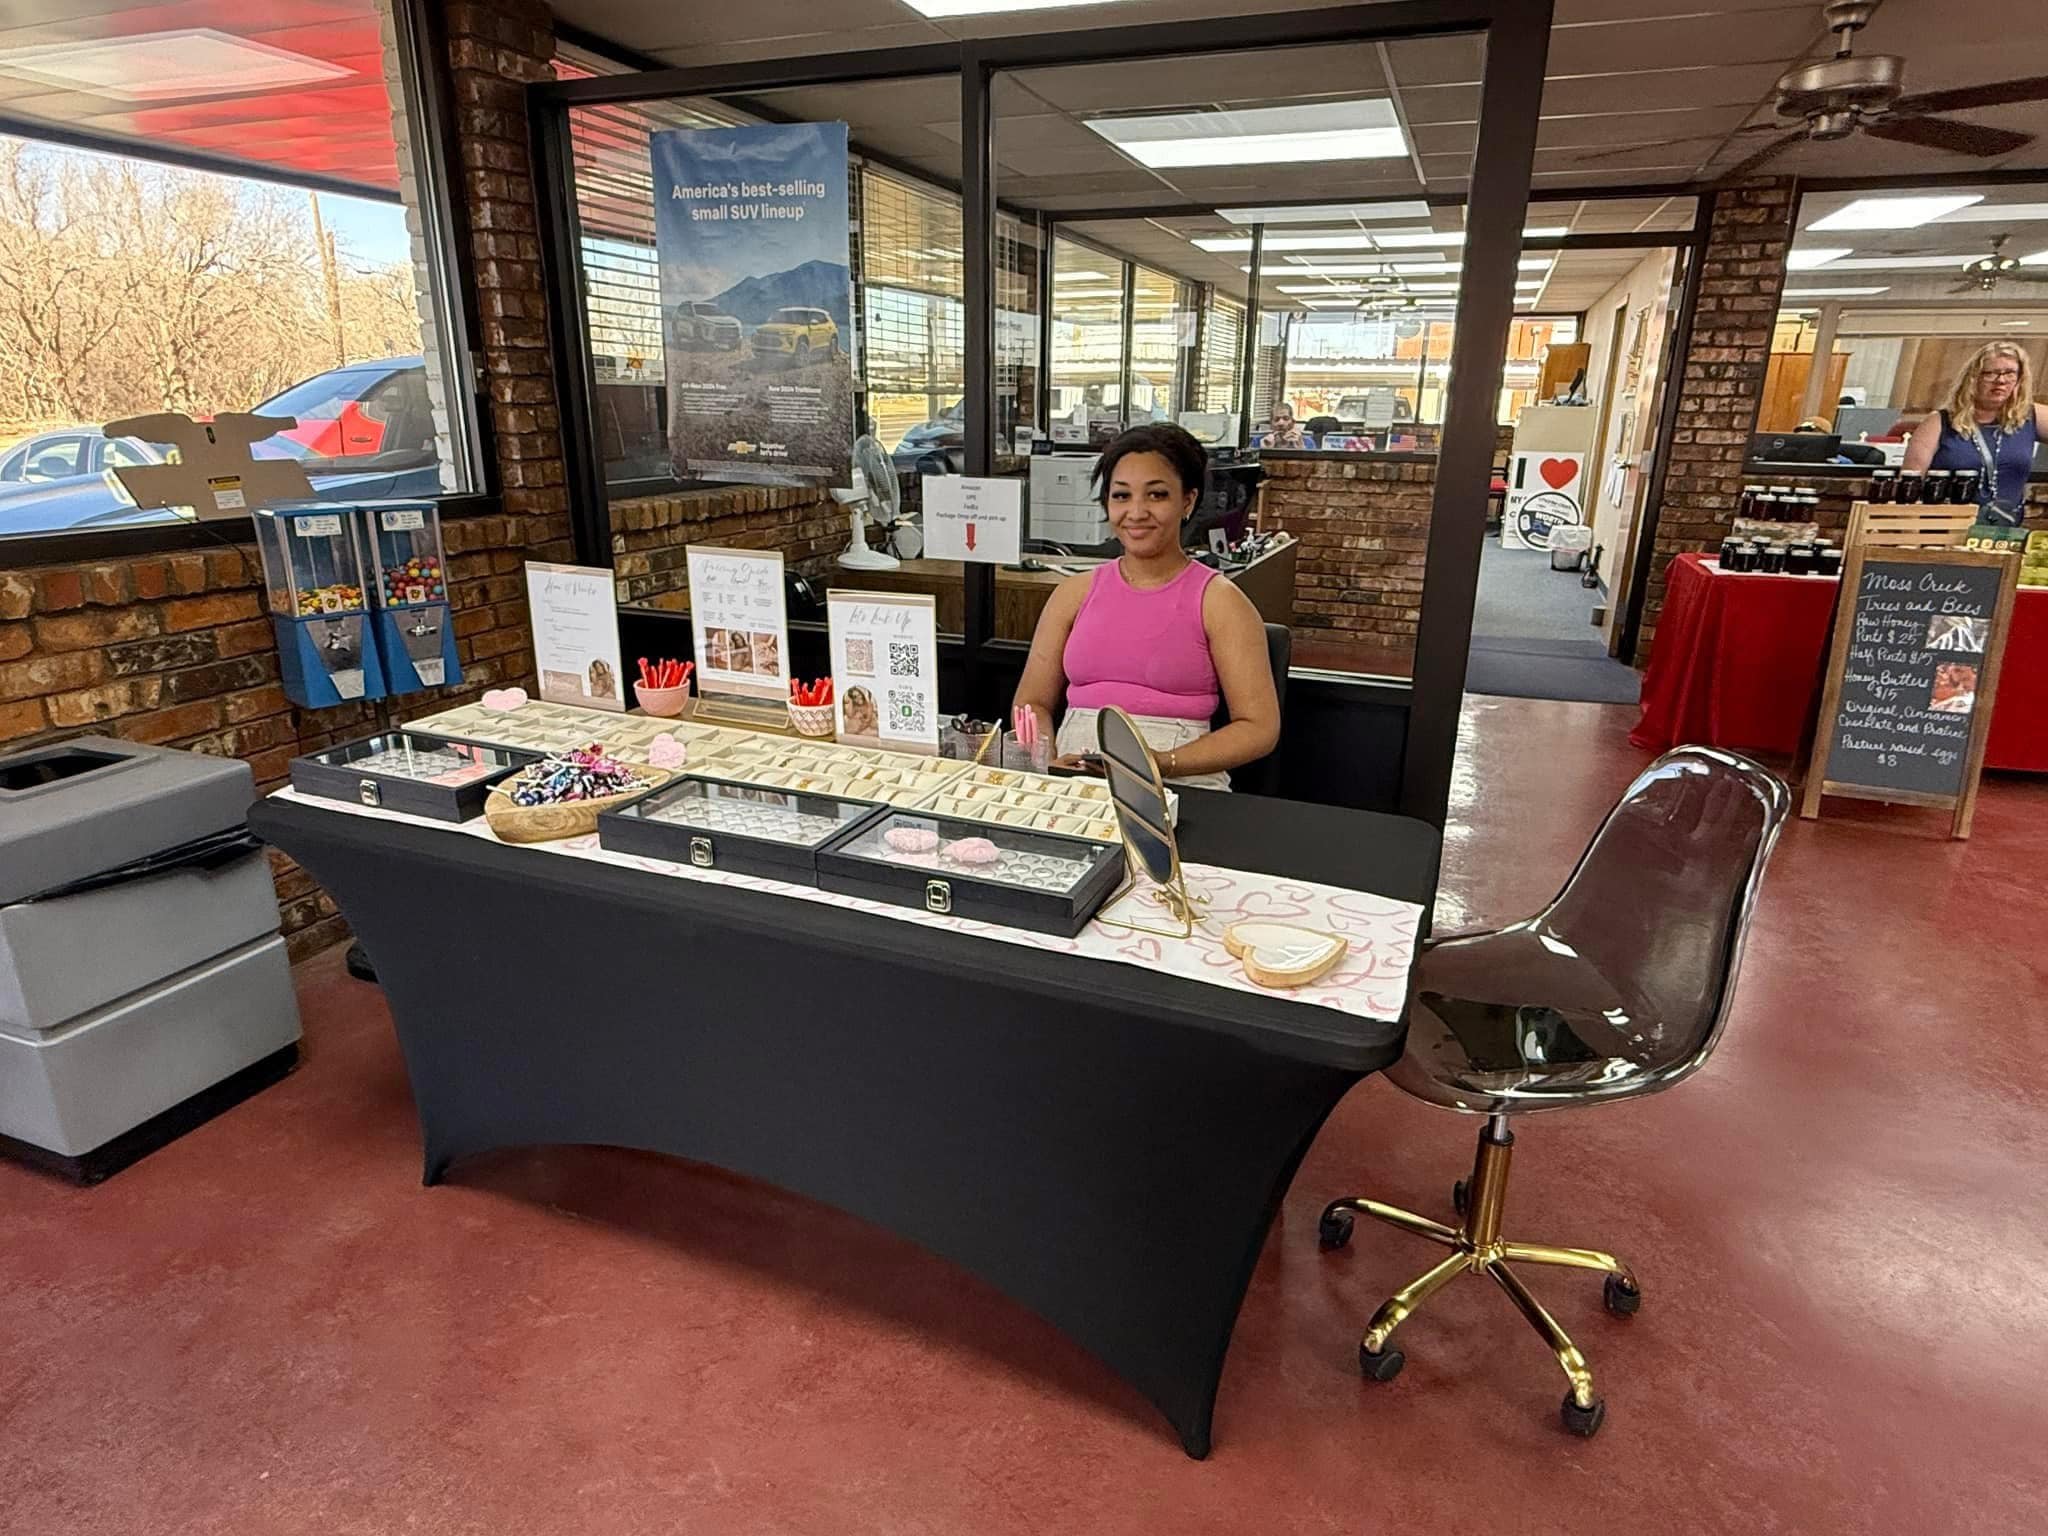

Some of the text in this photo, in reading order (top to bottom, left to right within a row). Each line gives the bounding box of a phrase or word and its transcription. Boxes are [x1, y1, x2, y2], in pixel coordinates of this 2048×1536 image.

[672, 179, 825, 199] America's best-selling
[692, 203, 805, 221] small SUV lineup
[1515, 458, 1527, 489] I
[1862, 572, 1972, 594] Moss Creek
[1859, 594, 1981, 615] Trees and Bees
[1857, 612, 1925, 635] Raw Honey
[1856, 626, 1883, 643] Pints
[1850, 645, 1938, 667] Half Pints $15
[1845, 667, 1928, 691] Honey Butters
[1874, 685, 1905, 701] $15
[1896, 722, 1919, 733] and
[1842, 735, 1957, 765] Pasture raised eggs
